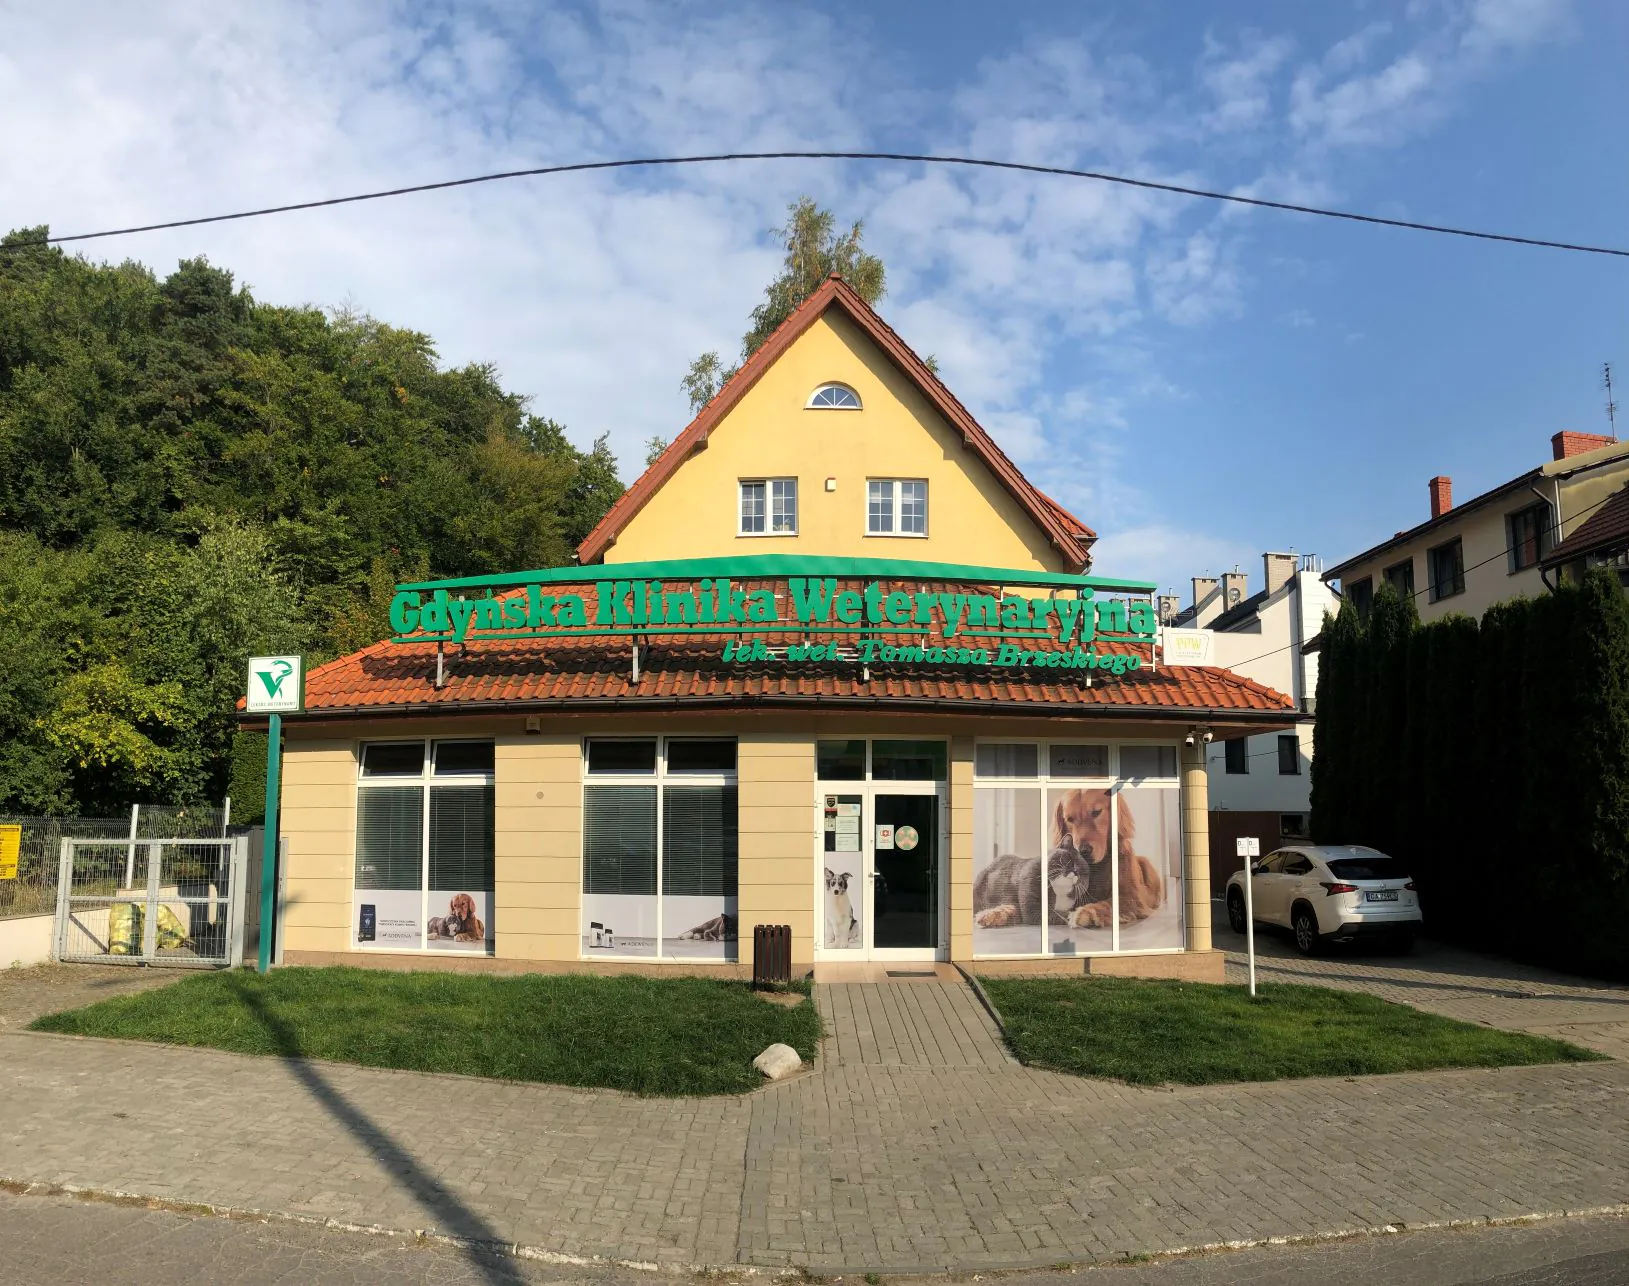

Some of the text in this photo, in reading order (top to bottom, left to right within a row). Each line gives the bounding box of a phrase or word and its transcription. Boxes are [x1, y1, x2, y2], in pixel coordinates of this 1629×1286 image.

[389, 578, 1157, 644] Gdyńska Klinika Weterynaryjna
[722, 638, 1142, 675] lek. wet. Tomasza Brzeskiego
